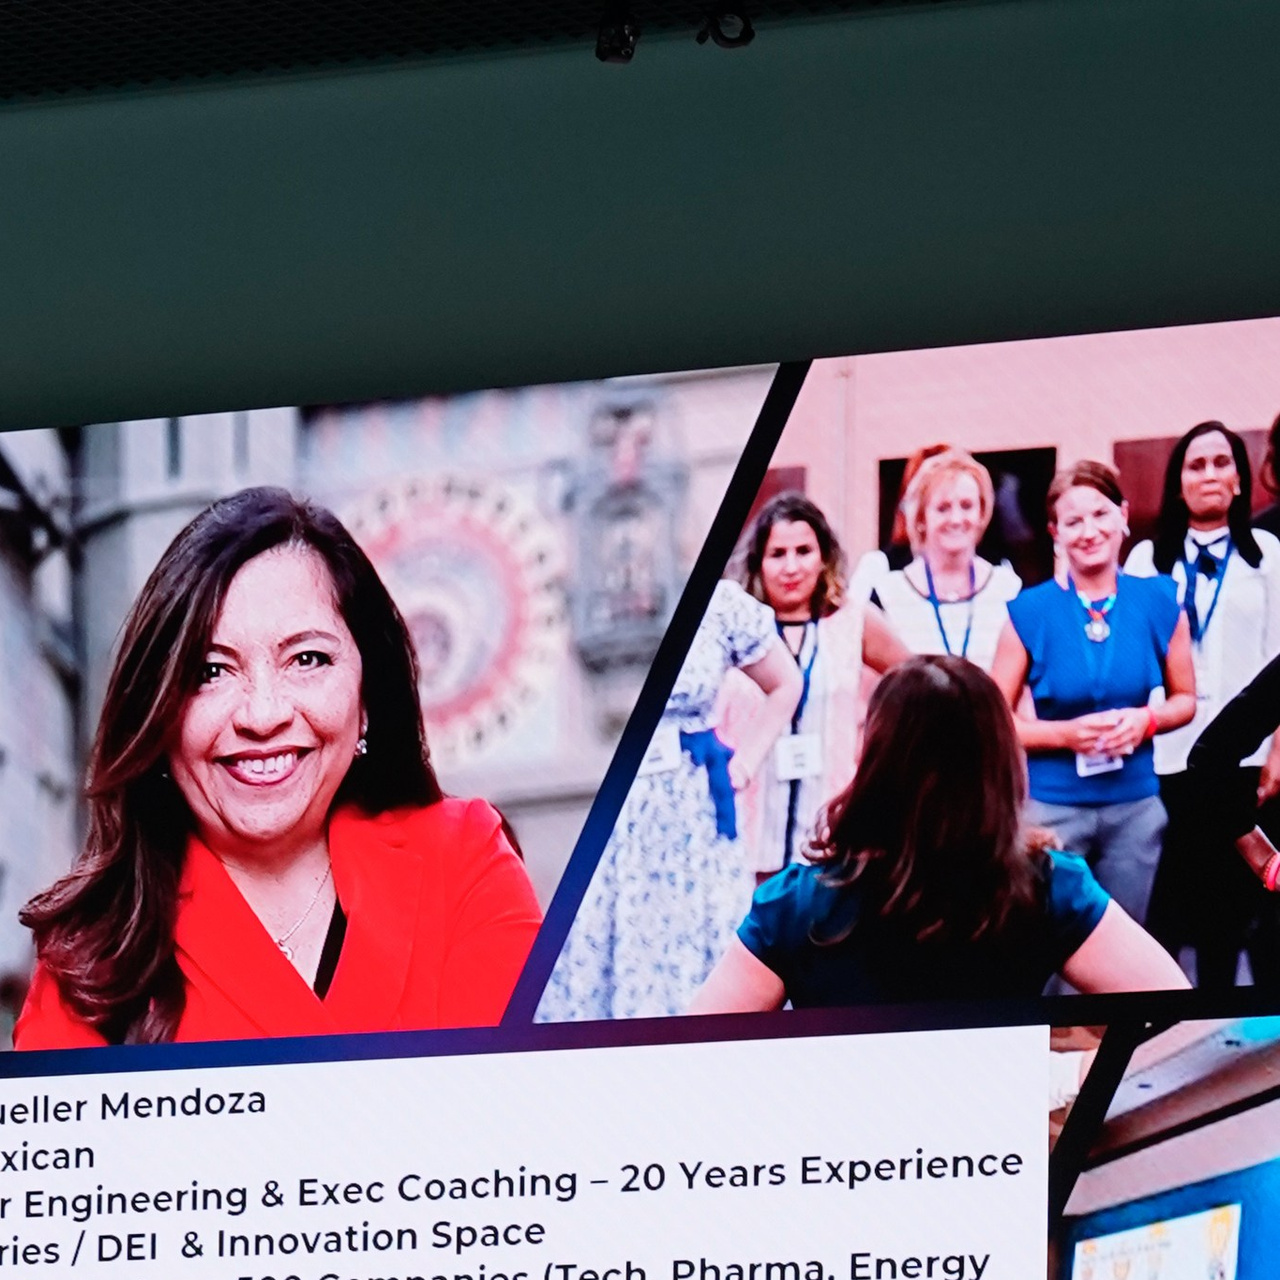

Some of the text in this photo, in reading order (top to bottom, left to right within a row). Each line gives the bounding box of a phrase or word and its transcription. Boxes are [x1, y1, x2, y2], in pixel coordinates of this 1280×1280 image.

[101, 1087, 266, 1121] Mendoza
[25, 1179, 247, 1223] Engineering
[261, 1180, 284, 1208] &
[299, 1178, 385, 1207] Exec
[397, 1165, 577, 1203] Coaching
[620, 1163, 666, 1193] 20
[678, 1161, 786, 1190] Years
[801, 1147, 1023, 1190] Experience
[70, 1229, 86, 1267] /
[97, 1232, 157, 1262] DEI
[181, 1231, 204, 1259] &
[218, 1220, 417, 1258] Innovation
[431, 1220, 546, 1255] Space
